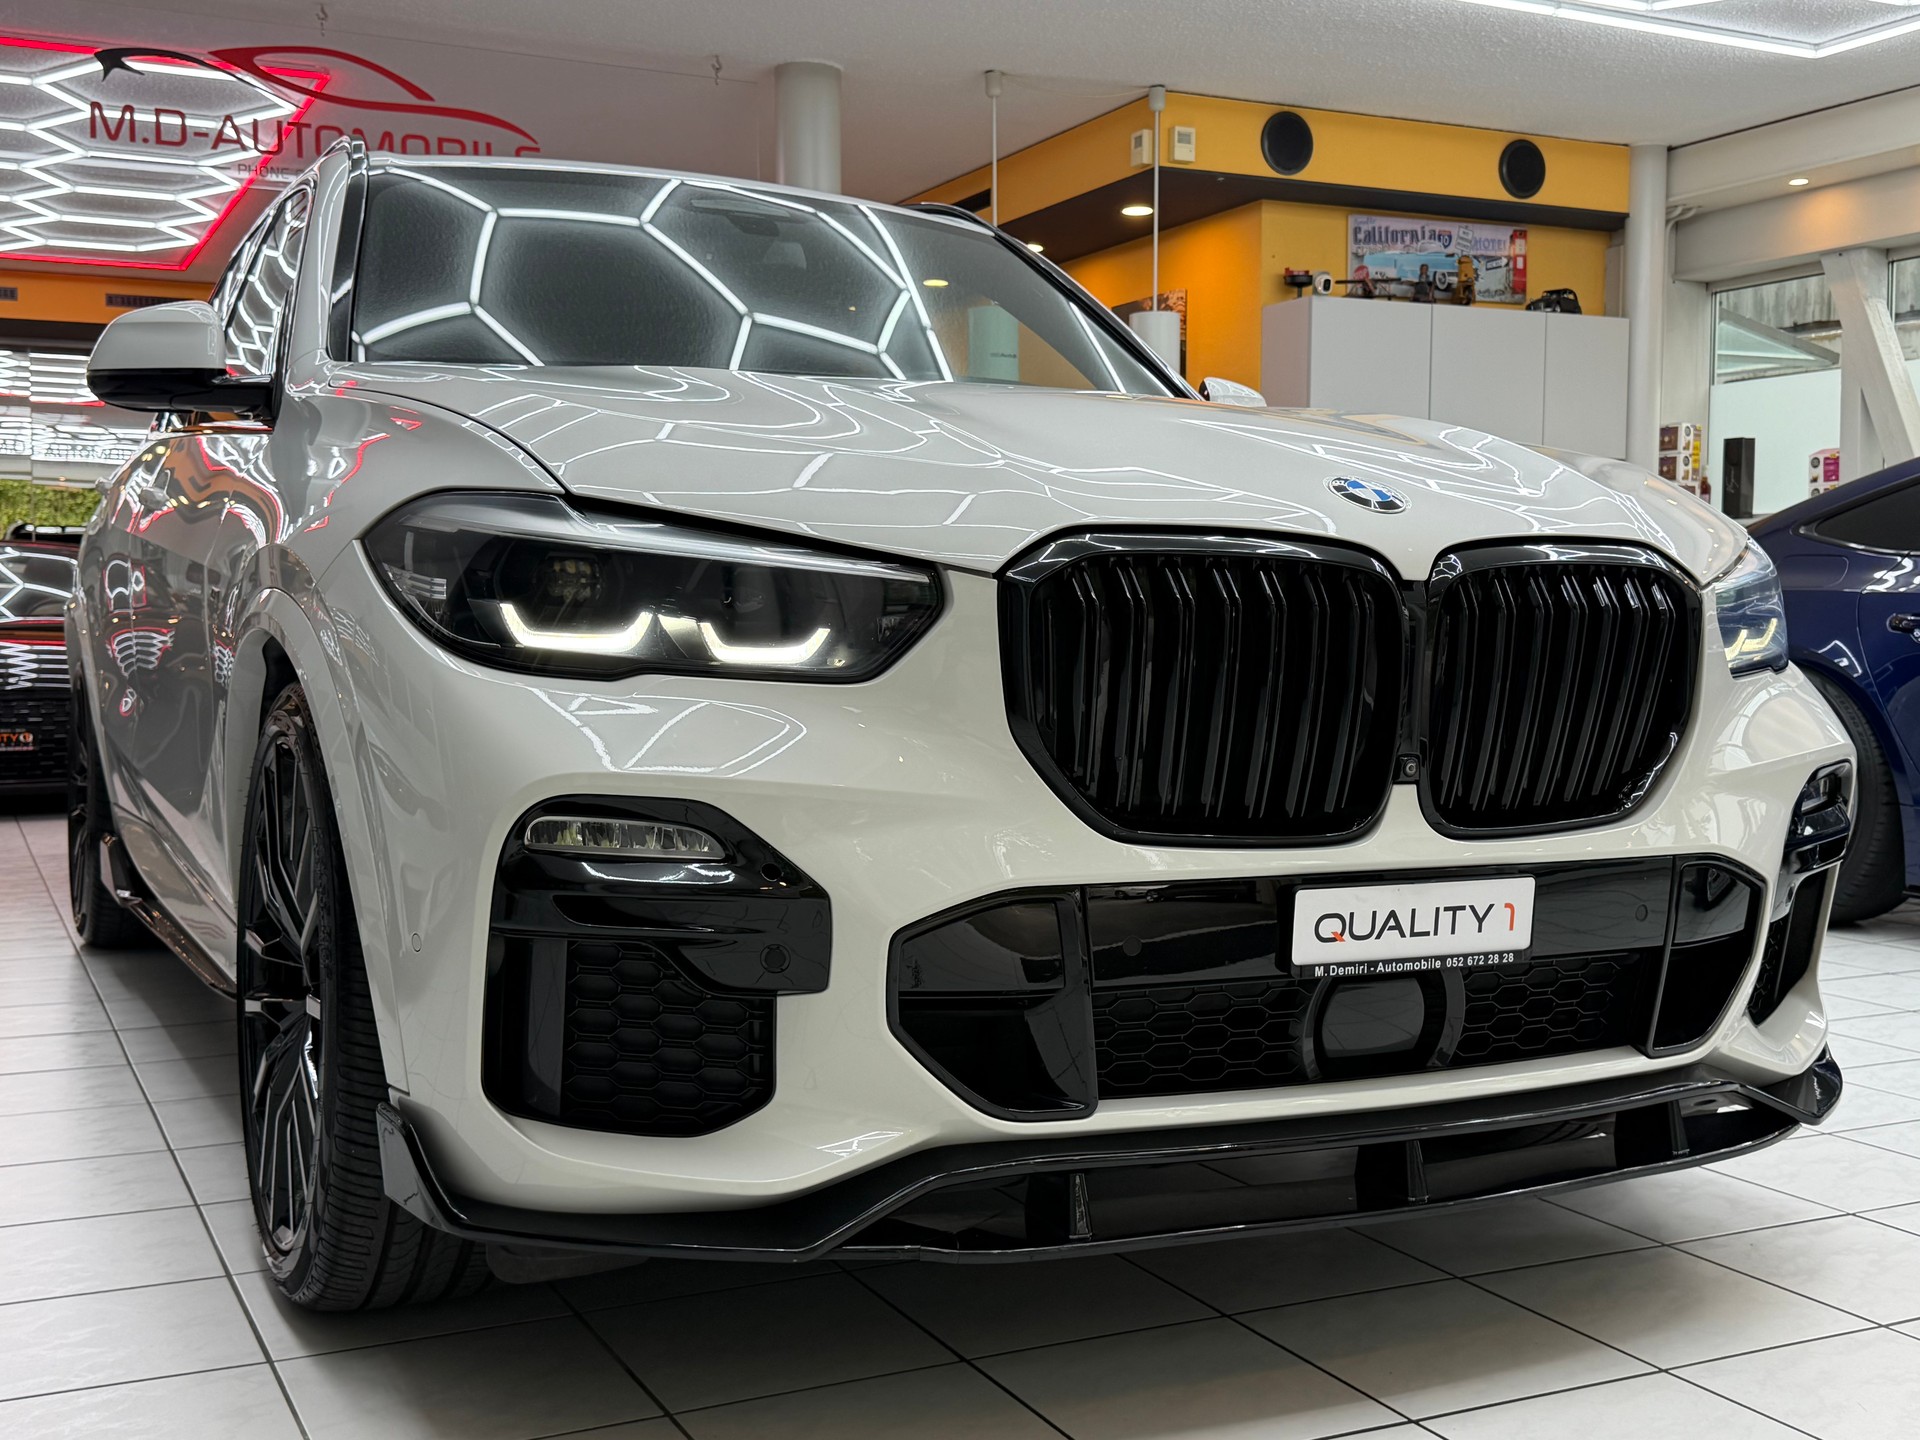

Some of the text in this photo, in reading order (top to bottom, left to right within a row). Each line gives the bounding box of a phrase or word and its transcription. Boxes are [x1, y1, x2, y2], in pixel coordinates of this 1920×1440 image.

[237, 163, 290, 179] PHONE
[1353, 226, 1436, 245] California
[1314, 902, 1515, 943] QUALITY 1
[1376, 959, 1441, 973] Automobile
[1446, 956, 1464, 967] 052
[1467, 955, 1485, 966] 672
[1488, 954, 1499, 964] 28
[1502, 952, 1514, 963] 28
